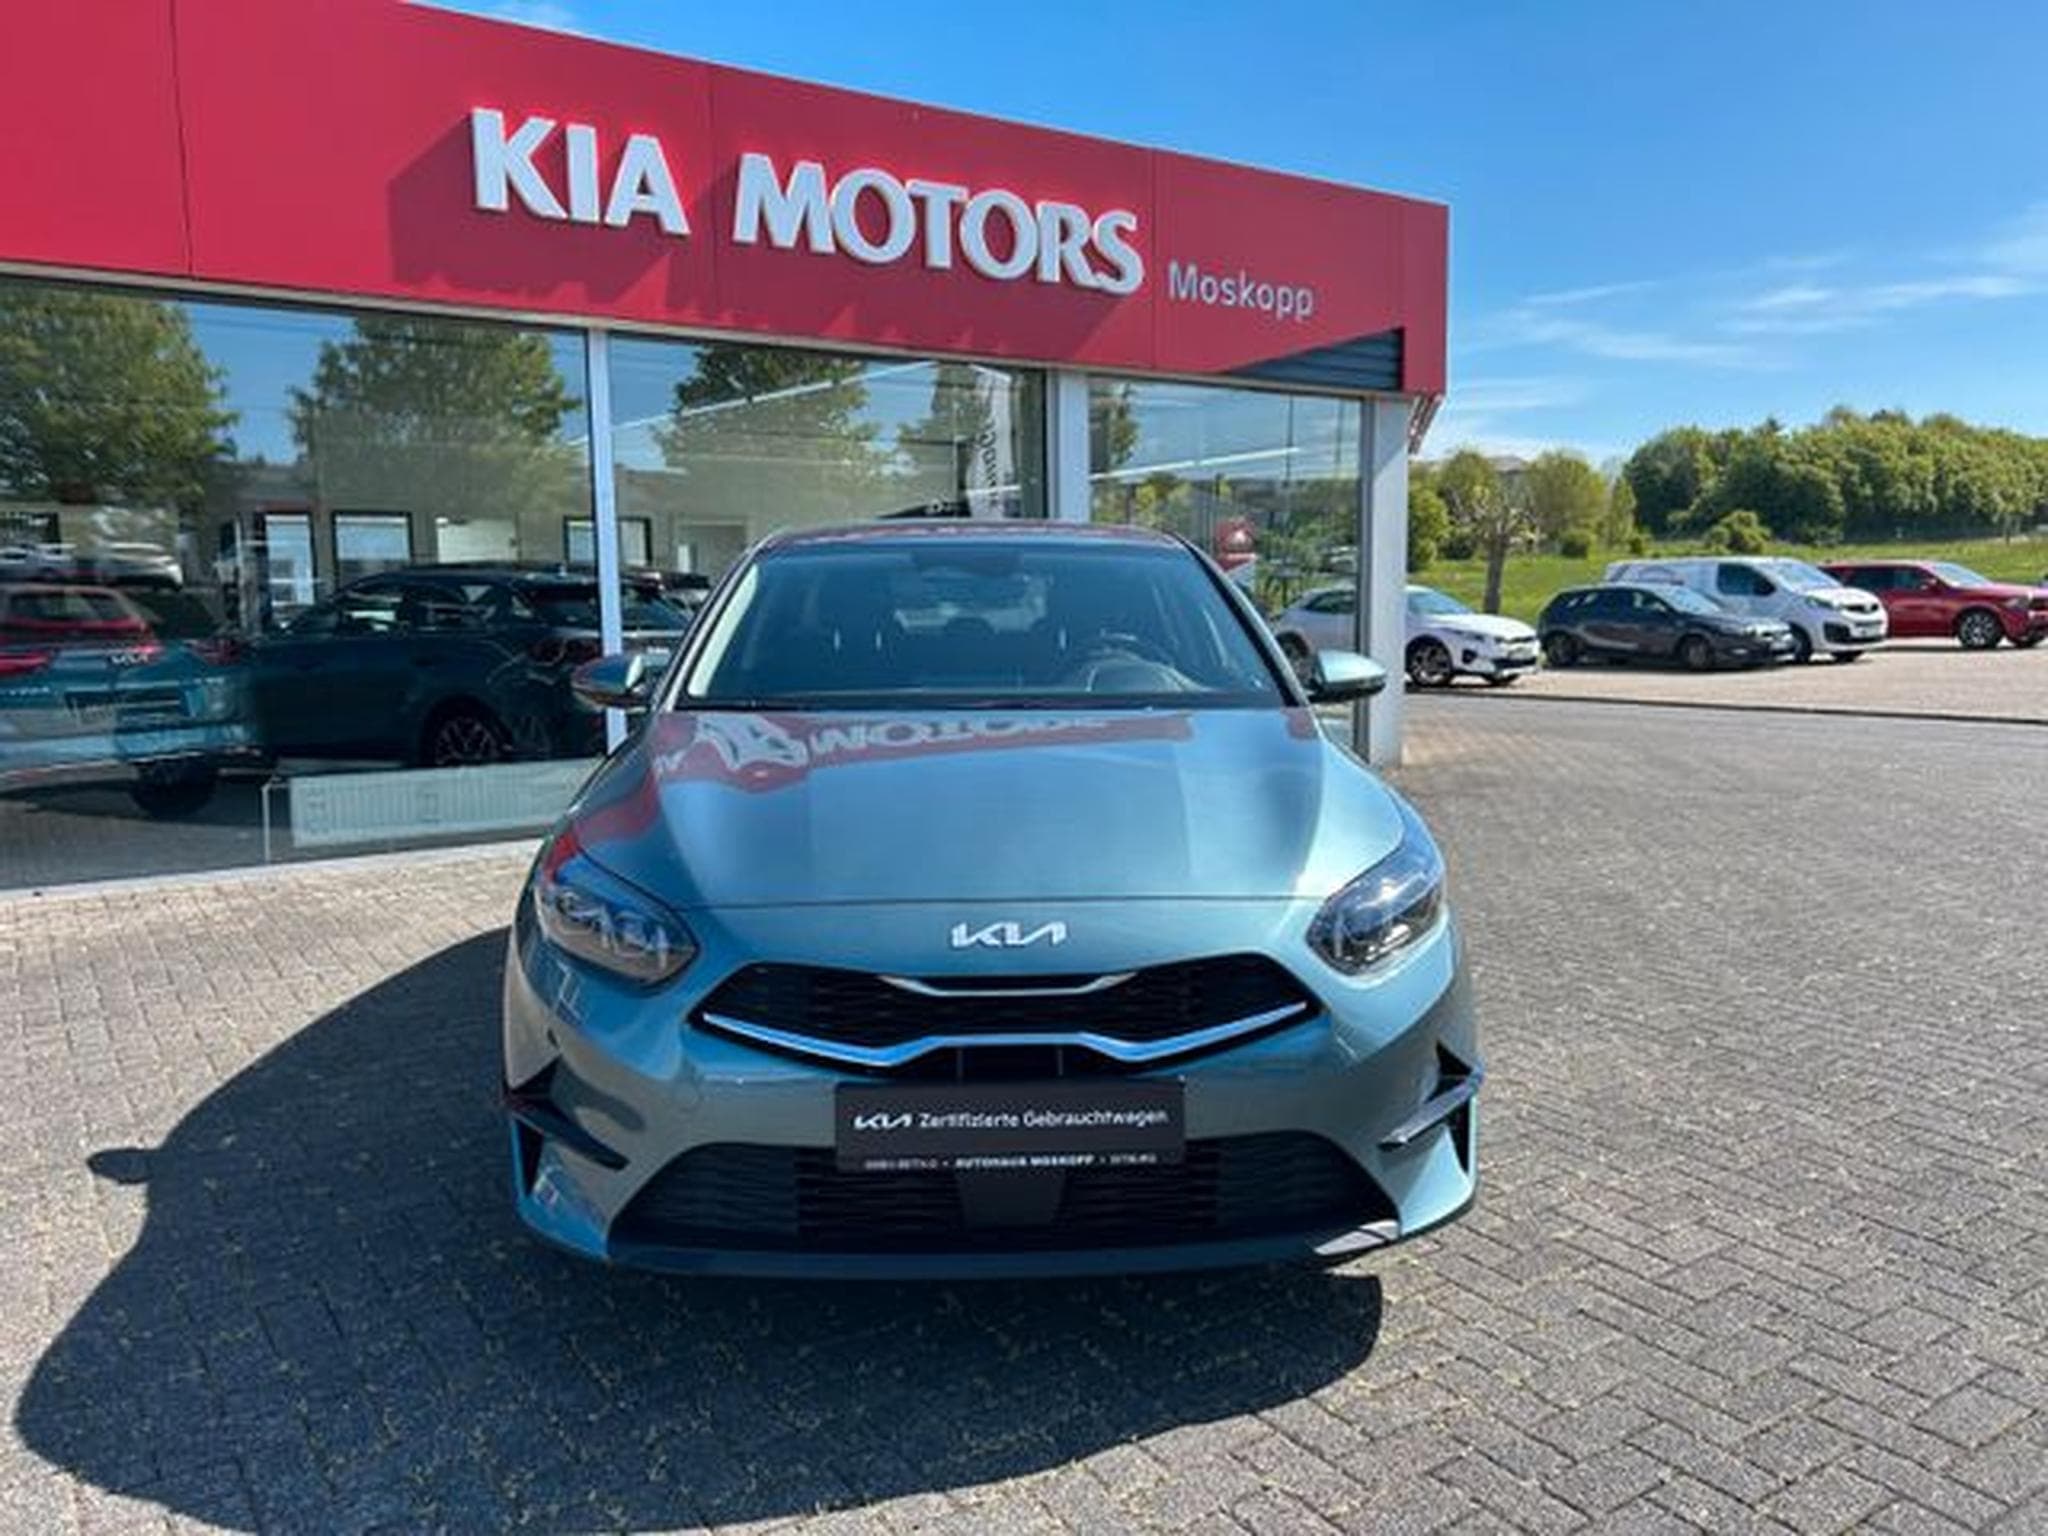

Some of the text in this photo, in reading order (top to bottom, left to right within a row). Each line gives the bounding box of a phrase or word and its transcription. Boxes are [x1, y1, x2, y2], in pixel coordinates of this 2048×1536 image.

[471, 108, 1145, 295] KIA MOTORS
[1168, 259, 1314, 321] Moskopp
[952, 921, 1067, 947] KIA
[854, 1109, 1168, 1129] KIA Zertifizierte Gebrauchtwagen
